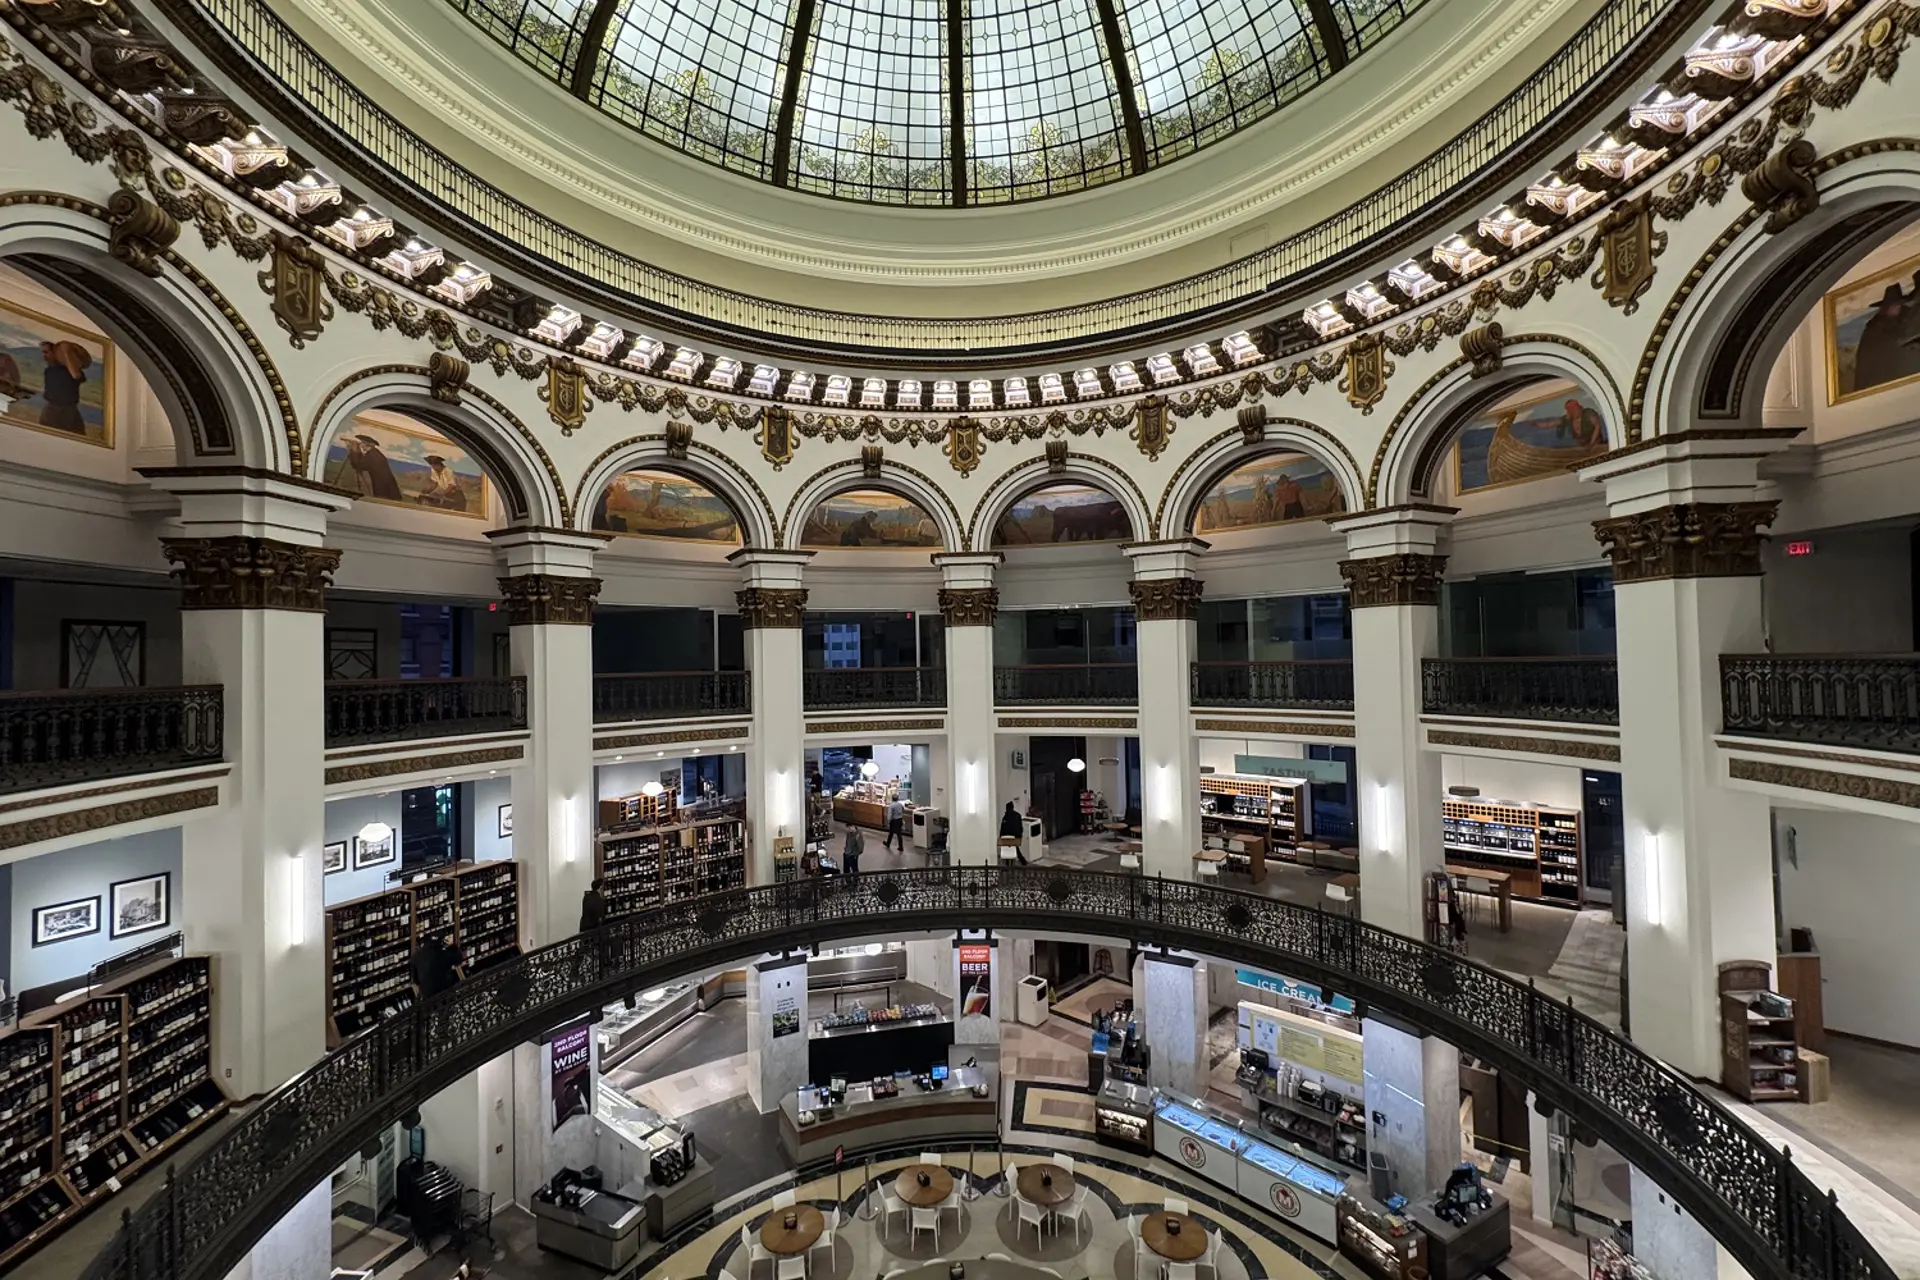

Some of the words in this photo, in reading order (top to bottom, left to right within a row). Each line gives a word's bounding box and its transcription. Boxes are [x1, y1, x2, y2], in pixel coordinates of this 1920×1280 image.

[1789, 542, 1811, 555] EXIT
[1262, 766, 1316, 780] TASTING
[961, 963, 988, 971] BEER
[1257, 979, 1277, 992] ICE
[553, 1046, 588, 1069] WINE
